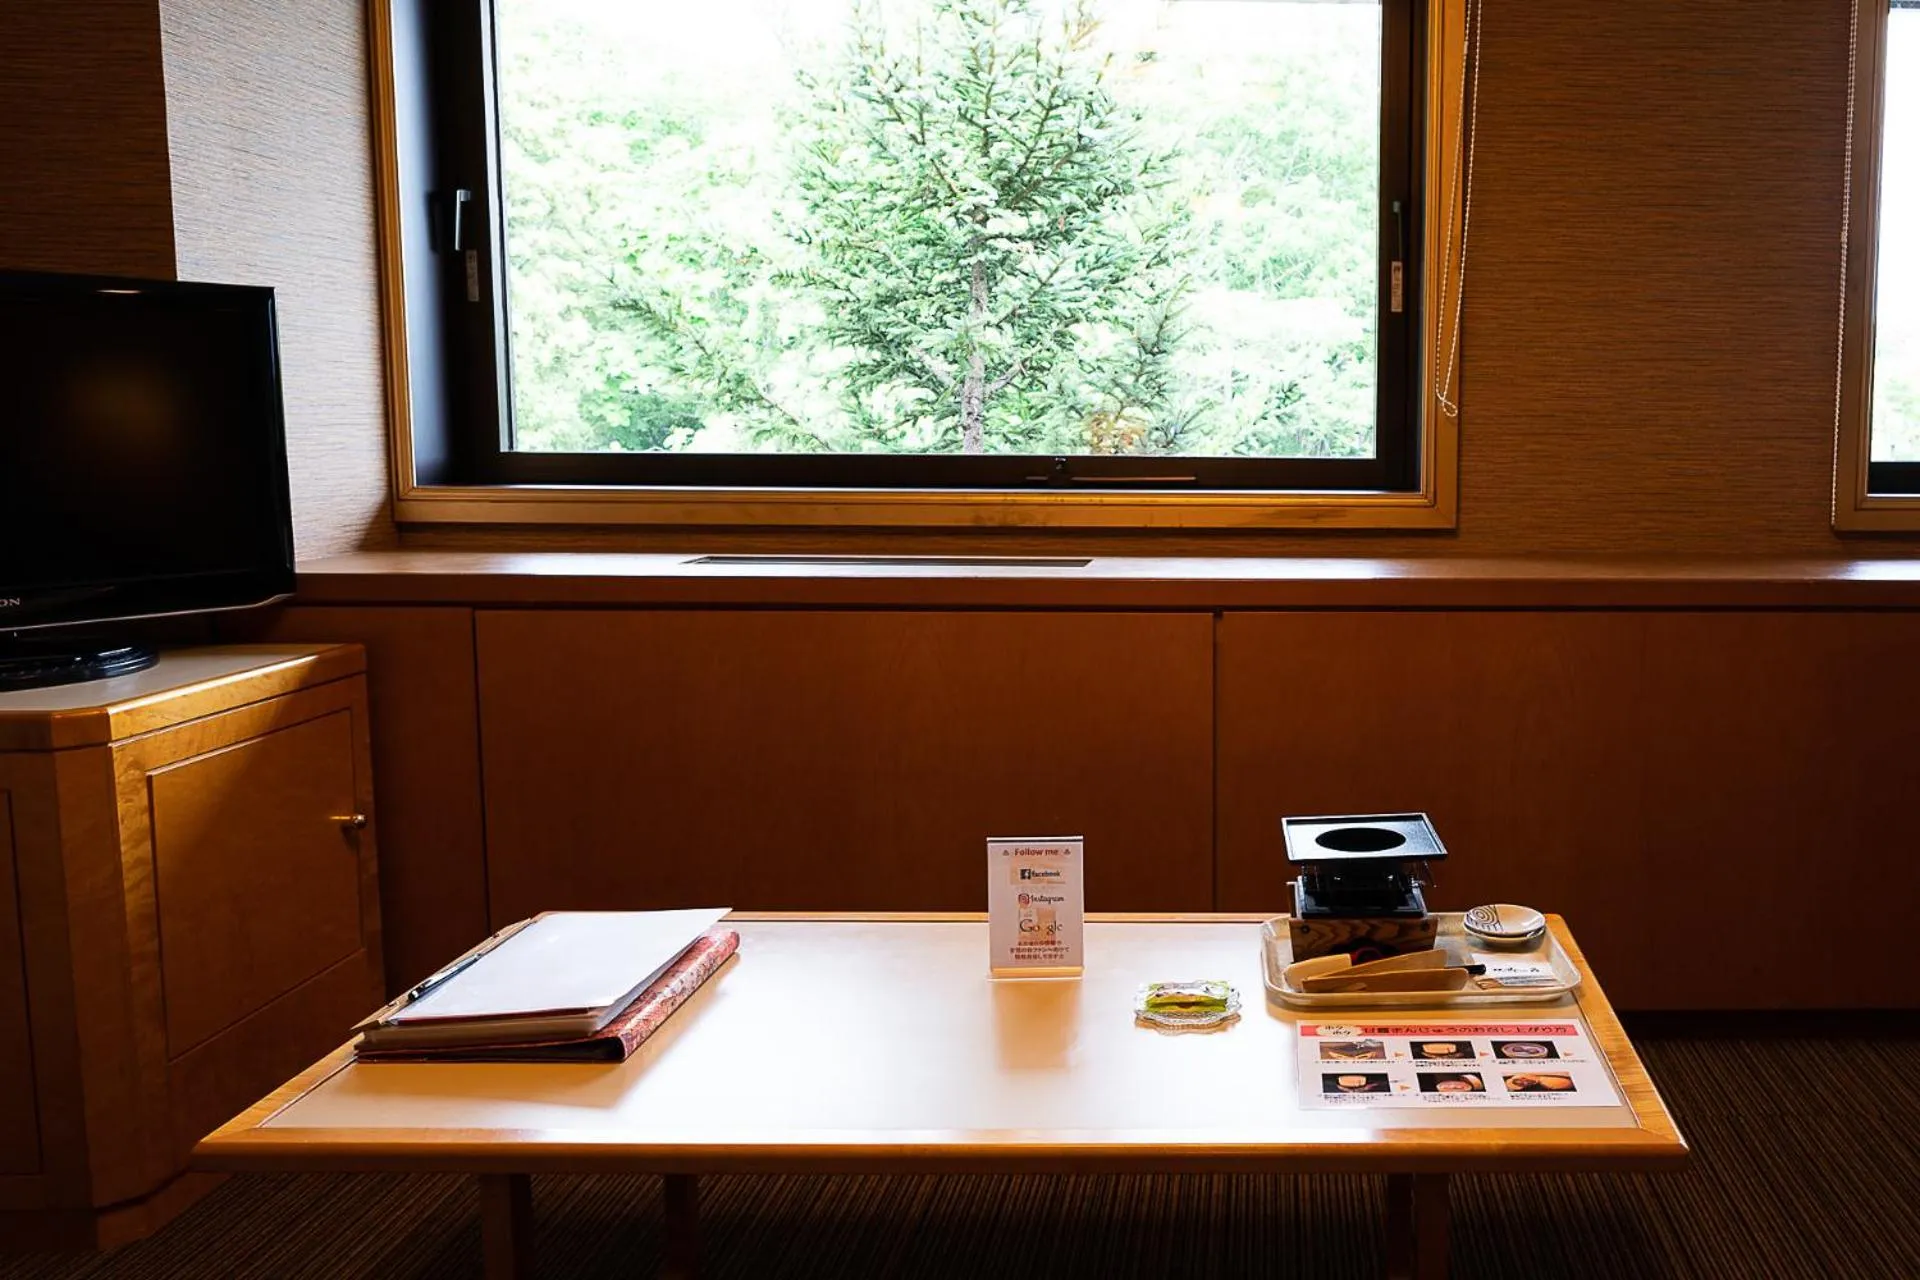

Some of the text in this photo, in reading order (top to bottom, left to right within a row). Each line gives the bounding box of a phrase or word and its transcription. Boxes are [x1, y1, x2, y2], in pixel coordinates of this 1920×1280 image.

[1014, 847, 1059, 856] Follow me
[1032, 869, 1061, 878] facebook
[1019, 918, 1063, 935] Gogle
